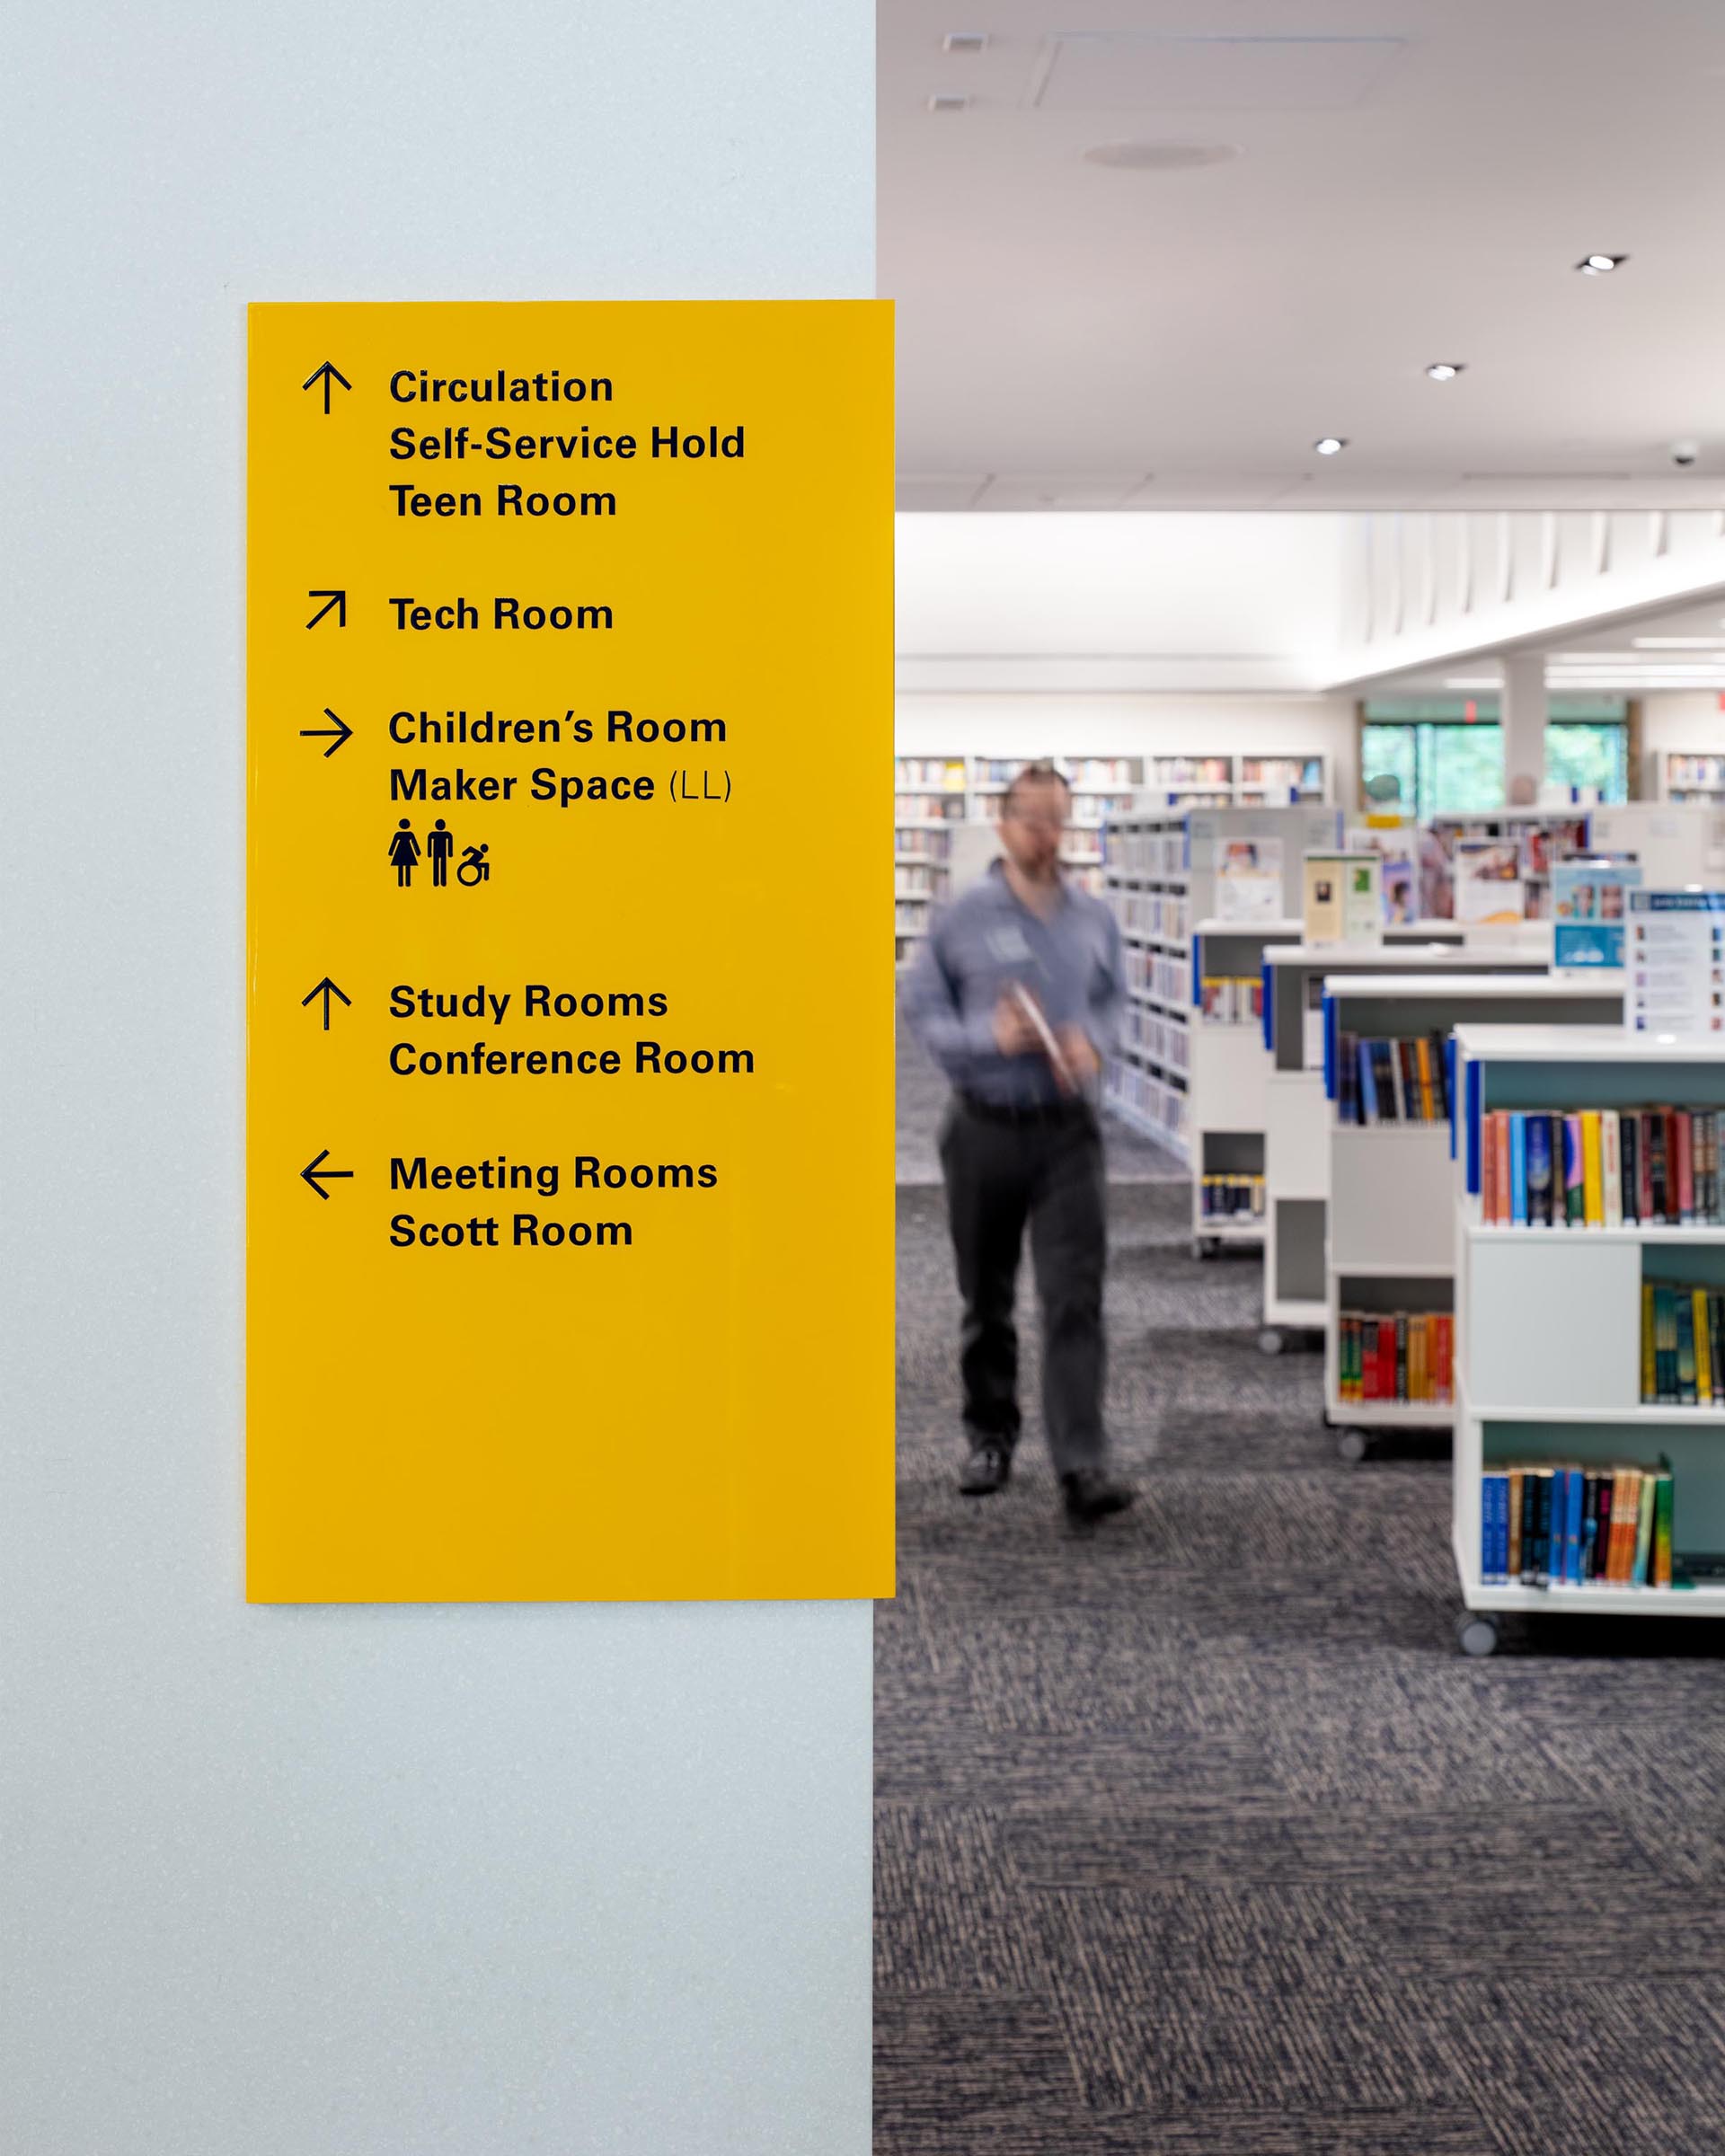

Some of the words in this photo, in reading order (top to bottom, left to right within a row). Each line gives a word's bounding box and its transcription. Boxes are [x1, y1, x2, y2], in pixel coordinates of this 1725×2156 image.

[390, 370, 613, 402] Circulation
[390, 426, 637, 460] Self-Service
[652, 426, 744, 458] Hold
[389, 484, 482, 517] Teen
[498, 484, 616, 516] Room
[389, 597, 479, 631] Tech
[494, 597, 613, 630] Room
[389, 711, 593, 744] Children’s
[608, 711, 726, 743] Room
[390, 768, 518, 800] Maker
[531, 768, 655, 808] Space
[669, 769, 732, 803] (LL)
[390, 985, 511, 1025] Study
[526, 985, 668, 1017] Rooms
[390, 1042, 621, 1075] Conference
[636, 1041, 754, 1074] Room
[391, 1156, 559, 1197] Meeting
[575, 1156, 718, 1188] Rooms
[390, 1215, 500, 1247] Scott
[514, 1214, 632, 1246] Room
